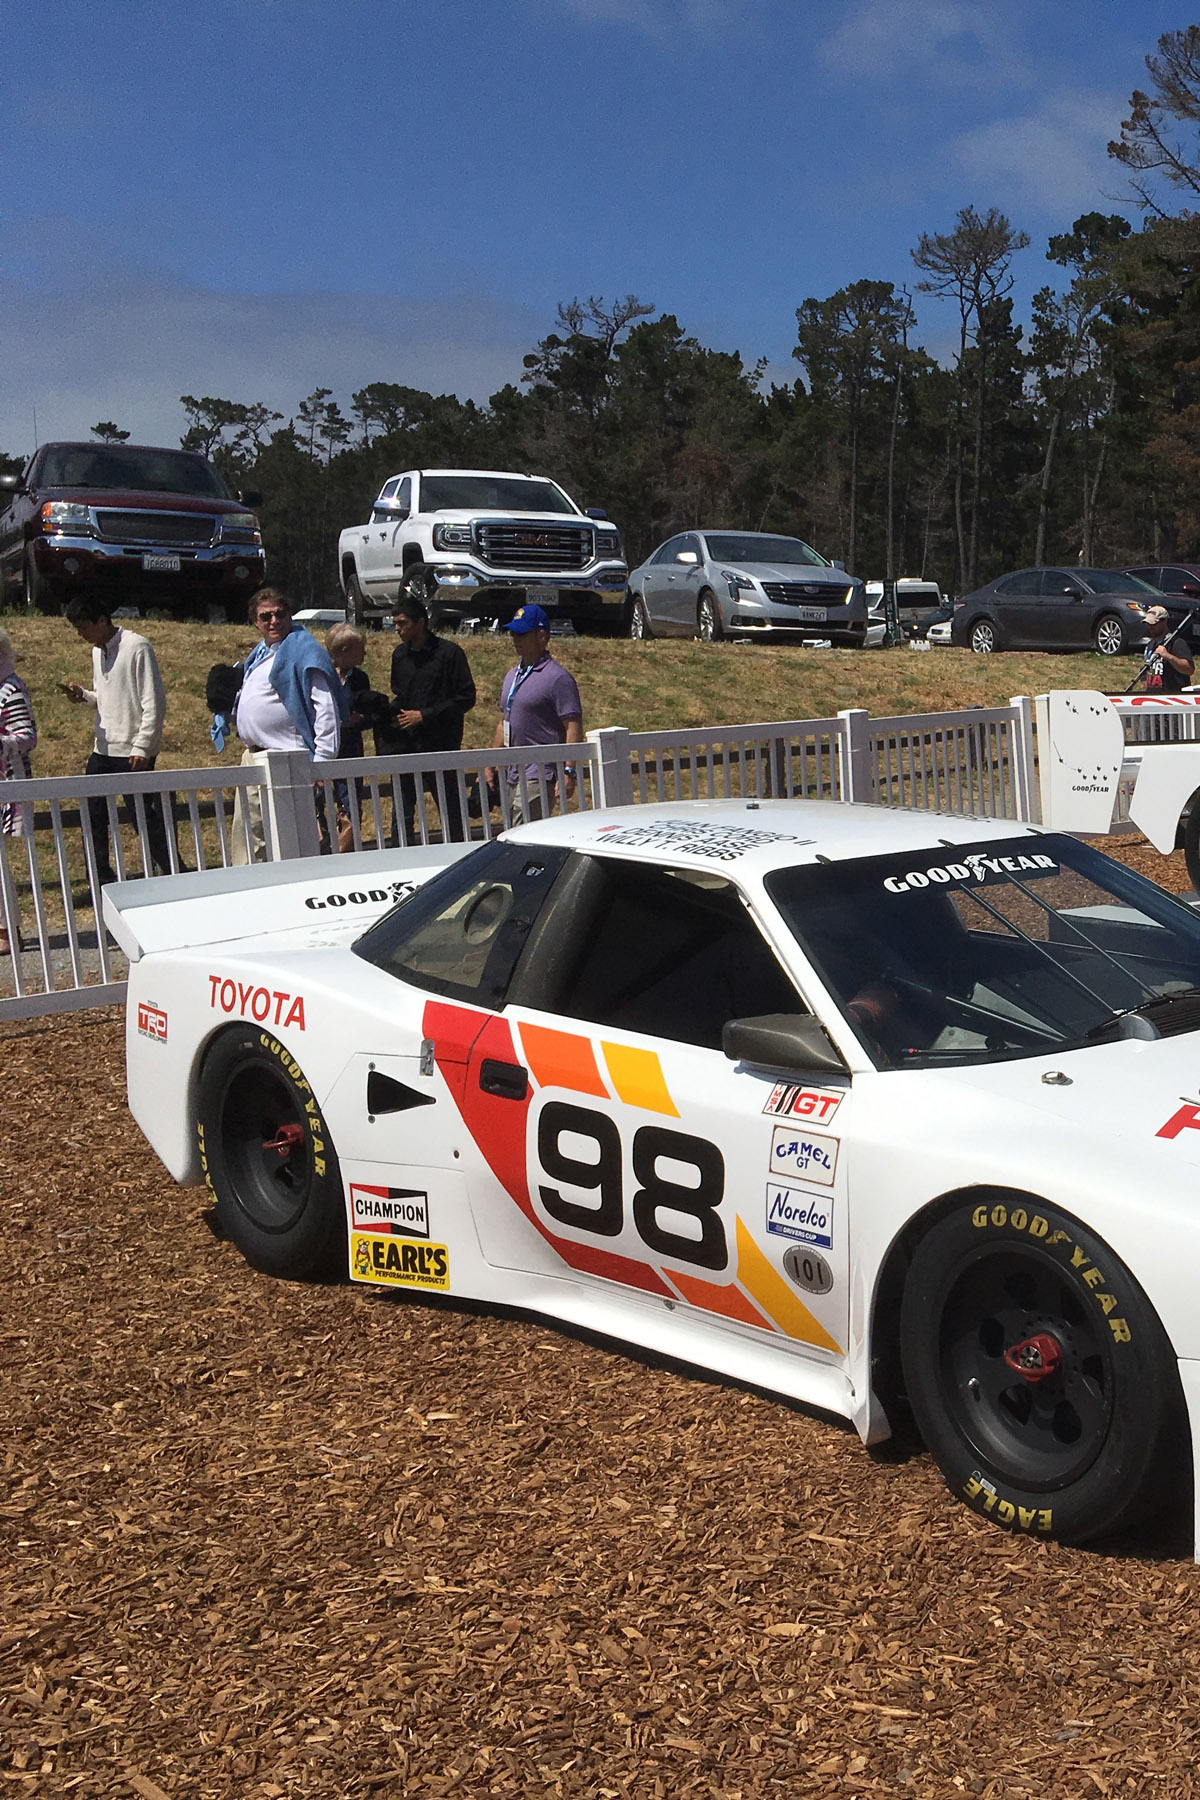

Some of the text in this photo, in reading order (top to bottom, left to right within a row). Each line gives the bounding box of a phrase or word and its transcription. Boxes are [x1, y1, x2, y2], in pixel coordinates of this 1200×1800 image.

[1071, 784, 1109, 793] GOODYEAR
[596, 833, 659, 848] WILLY
[672, 843, 745, 861] RIBBS
[883, 854, 1059, 893] GOODYEAR
[209, 974, 306, 1032] TOYOTA
[139, 1007, 167, 1036] TRD
[793, 1092, 840, 1118] GT
[775, 1141, 831, 1170] CAMEL
[796, 1156, 810, 1170] GT
[537, 1100, 728, 1272] 98
[355, 1199, 424, 1222] CHAMPION
[769, 1190, 827, 1229] Norelco
[373, 1241, 448, 1276] EARL'S
[793, 1255, 824, 1285] 101
[375, 1269, 446, 1285] PERFORMANCE PRODUCTS
[972, 1205, 1132, 1344] GOODYEAR
[963, 1477, 1053, 1532] EAGLE
